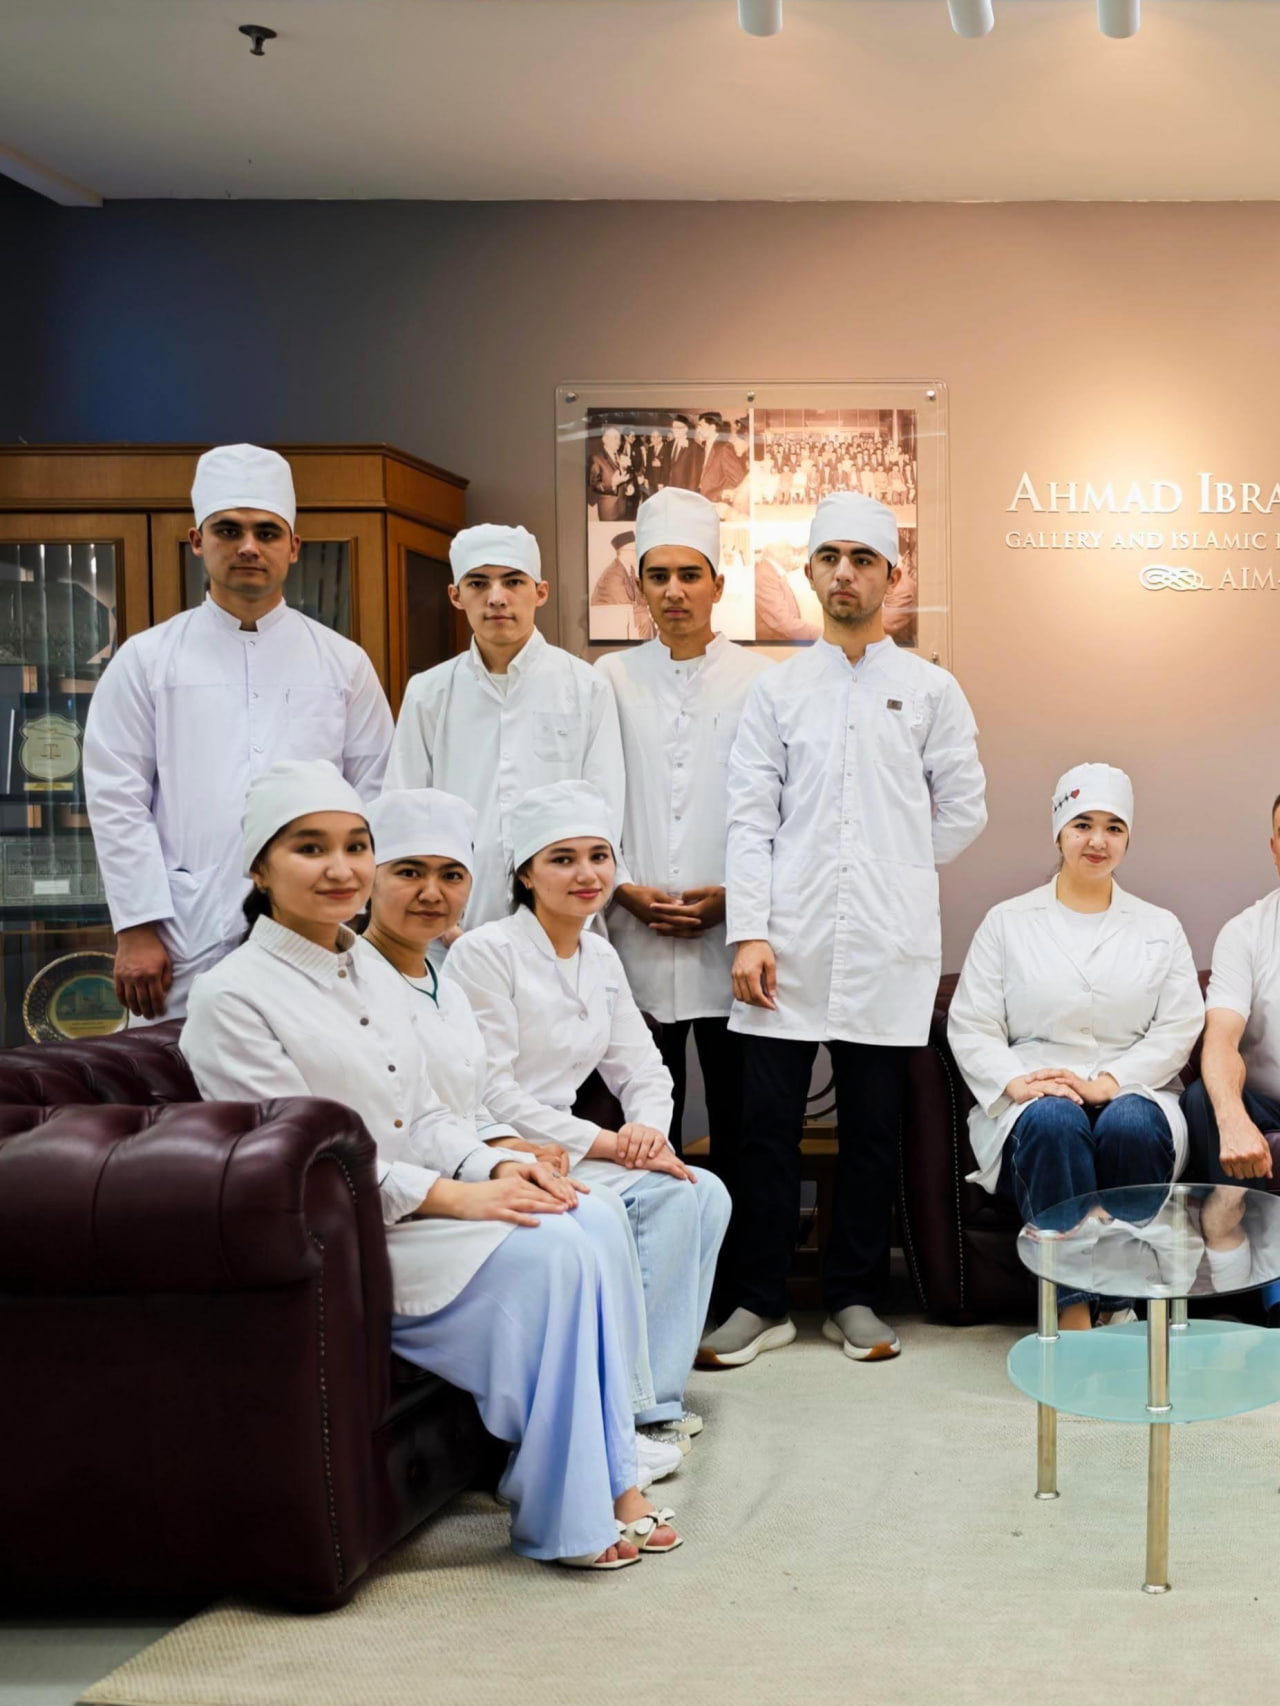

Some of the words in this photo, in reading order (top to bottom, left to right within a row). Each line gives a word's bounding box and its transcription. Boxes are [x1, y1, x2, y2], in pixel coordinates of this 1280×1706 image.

[1005, 471, 1183, 514] AHMAD
[1005, 530, 1104, 550] GALLERY
[1110, 530, 1164, 550] AND
[1171, 530, 1267, 551] ISLAMIC
